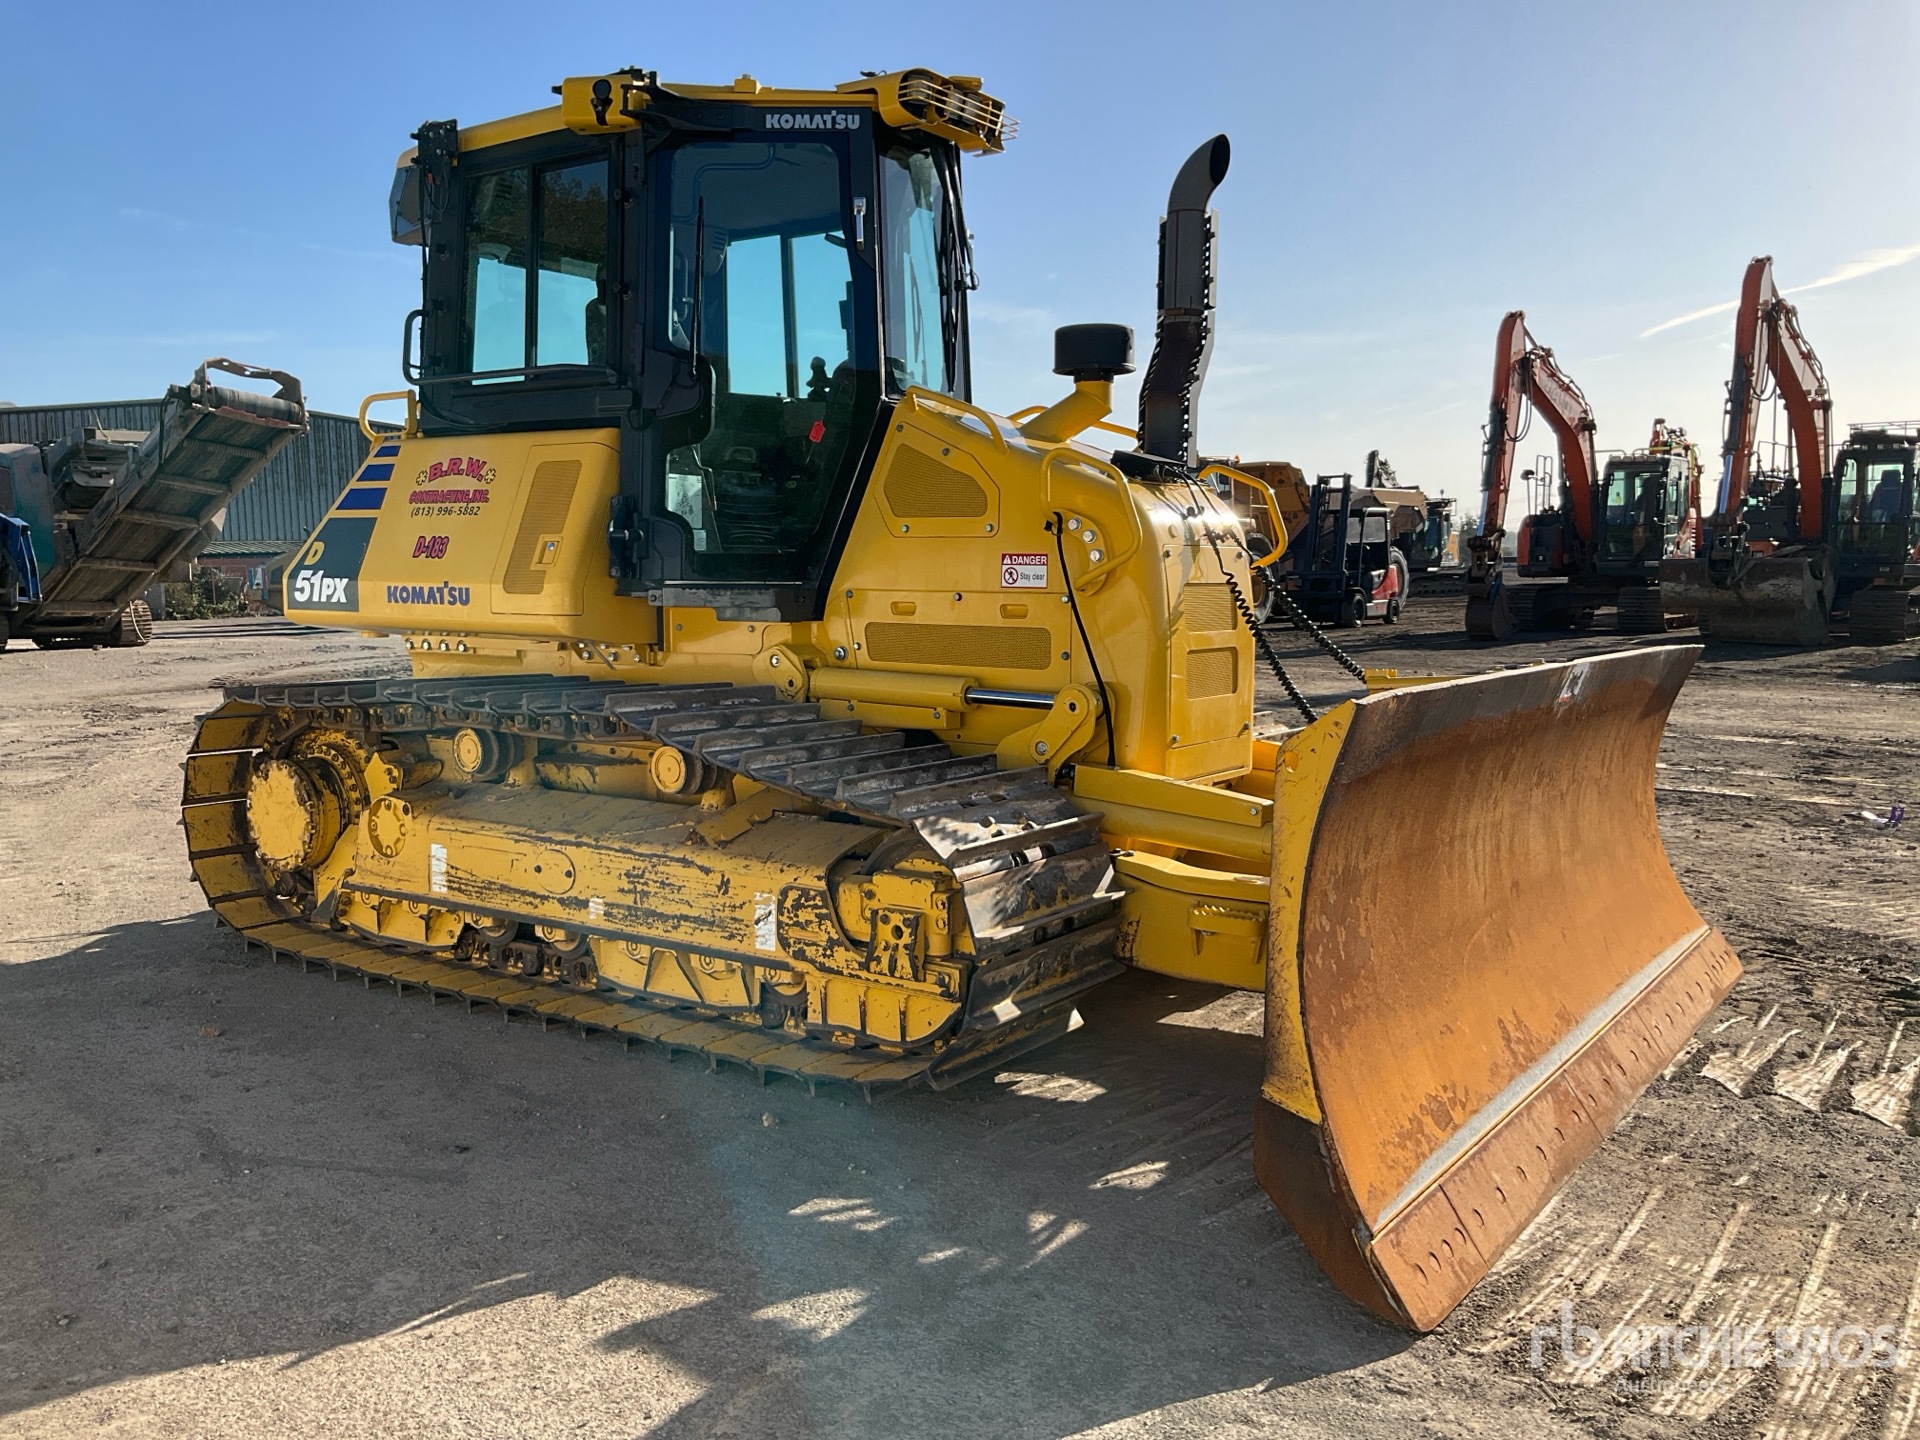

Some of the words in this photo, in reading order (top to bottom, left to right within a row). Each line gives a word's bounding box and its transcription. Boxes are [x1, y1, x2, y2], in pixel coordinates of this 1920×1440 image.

[765, 110, 860, 130] KOMATSU
[428, 457, 488, 483] B.R.W.
[411, 506, 434, 518] (813)
[436, 506, 481, 516] 996-5882
[304, 541, 325, 566] D
[412, 536, 450, 559] D-183
[1012, 555, 1047, 565] DANGER
[293, 569, 349, 603] 51PX
[1020, 572, 1031, 581] Stay
[386, 581, 471, 606] KOMATSU
